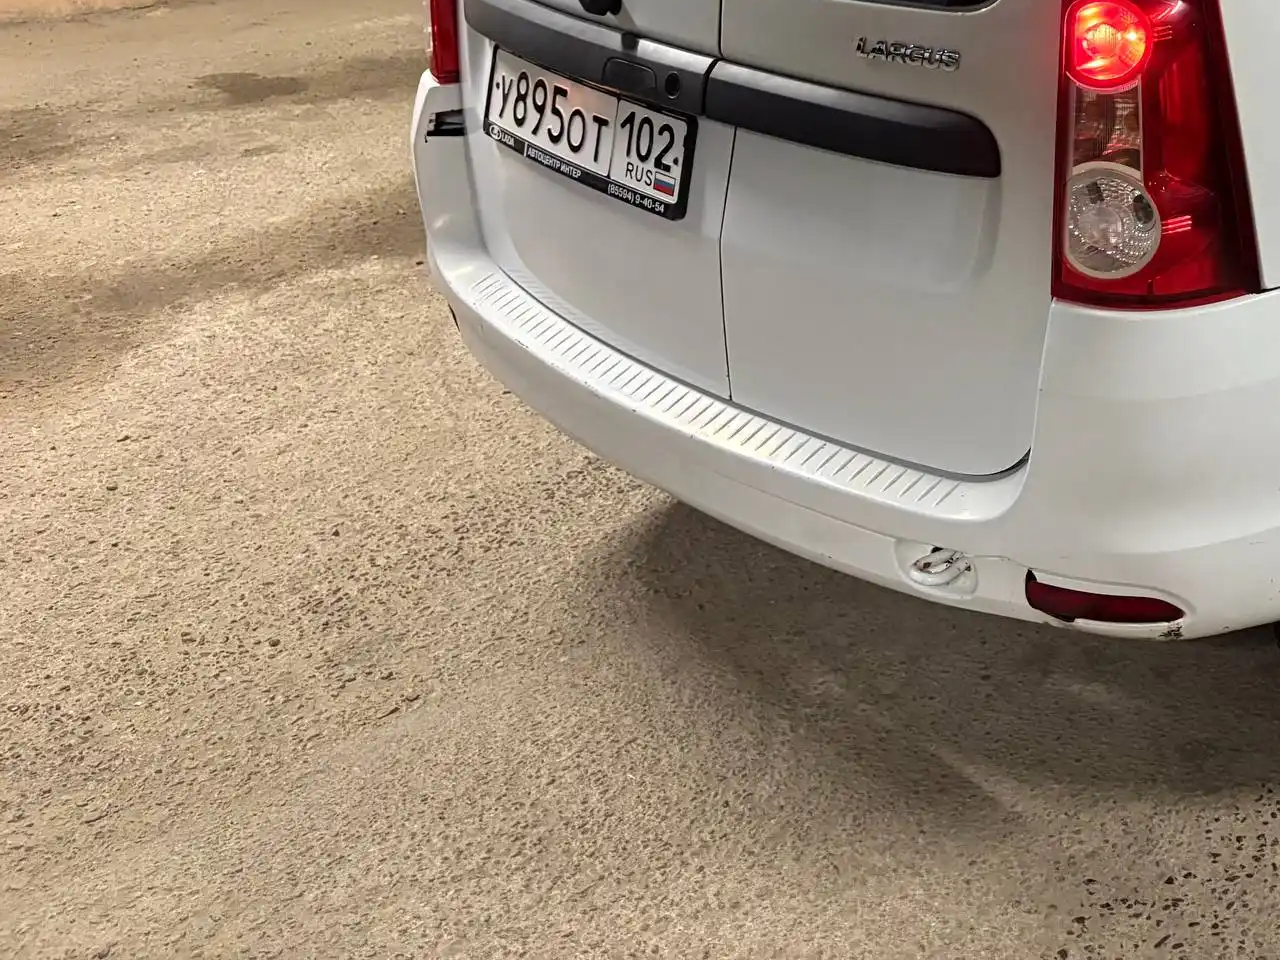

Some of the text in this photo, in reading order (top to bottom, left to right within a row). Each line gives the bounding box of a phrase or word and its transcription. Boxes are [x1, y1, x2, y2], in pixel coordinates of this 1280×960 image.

[855, 35, 961, 72] LARGUS
[501, 131, 515, 146] LADA
[620, 110, 675, 173] 102
[527, 147, 582, 179] АВТОЦЕНТР ИНТЕР
[625, 161, 653, 186] RUS
[607, 183, 665, 213] (85594) 9-40-54
